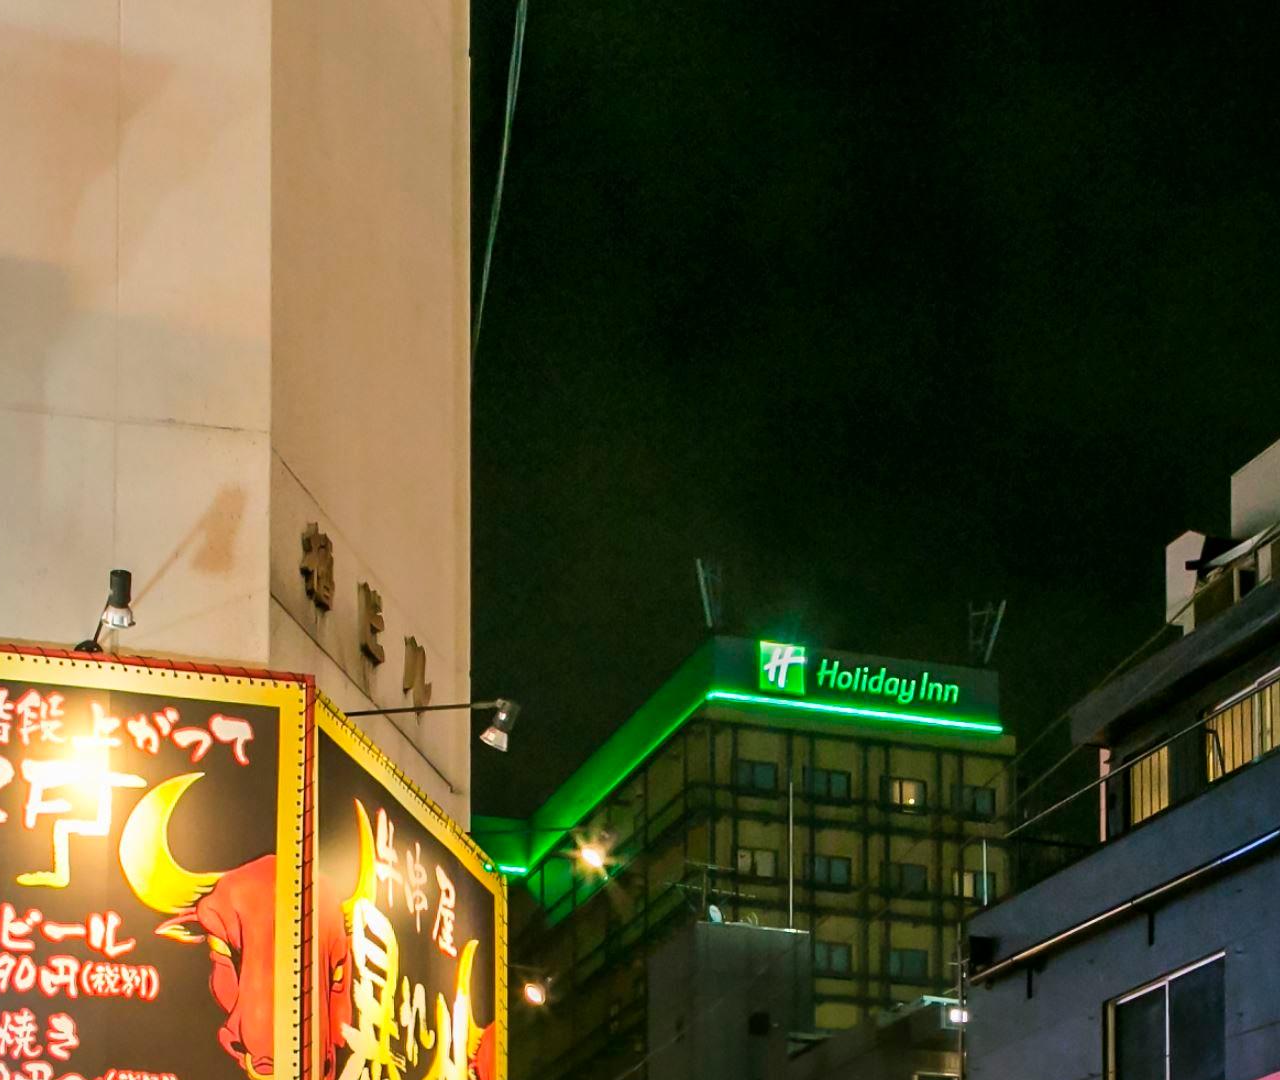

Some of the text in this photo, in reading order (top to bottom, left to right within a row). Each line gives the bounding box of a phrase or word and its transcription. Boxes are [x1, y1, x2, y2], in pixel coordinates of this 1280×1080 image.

[818, 659, 915, 704] Holiday
[920, 671, 959, 704] Inn
[375, 807, 458, 957] 牛串屋
